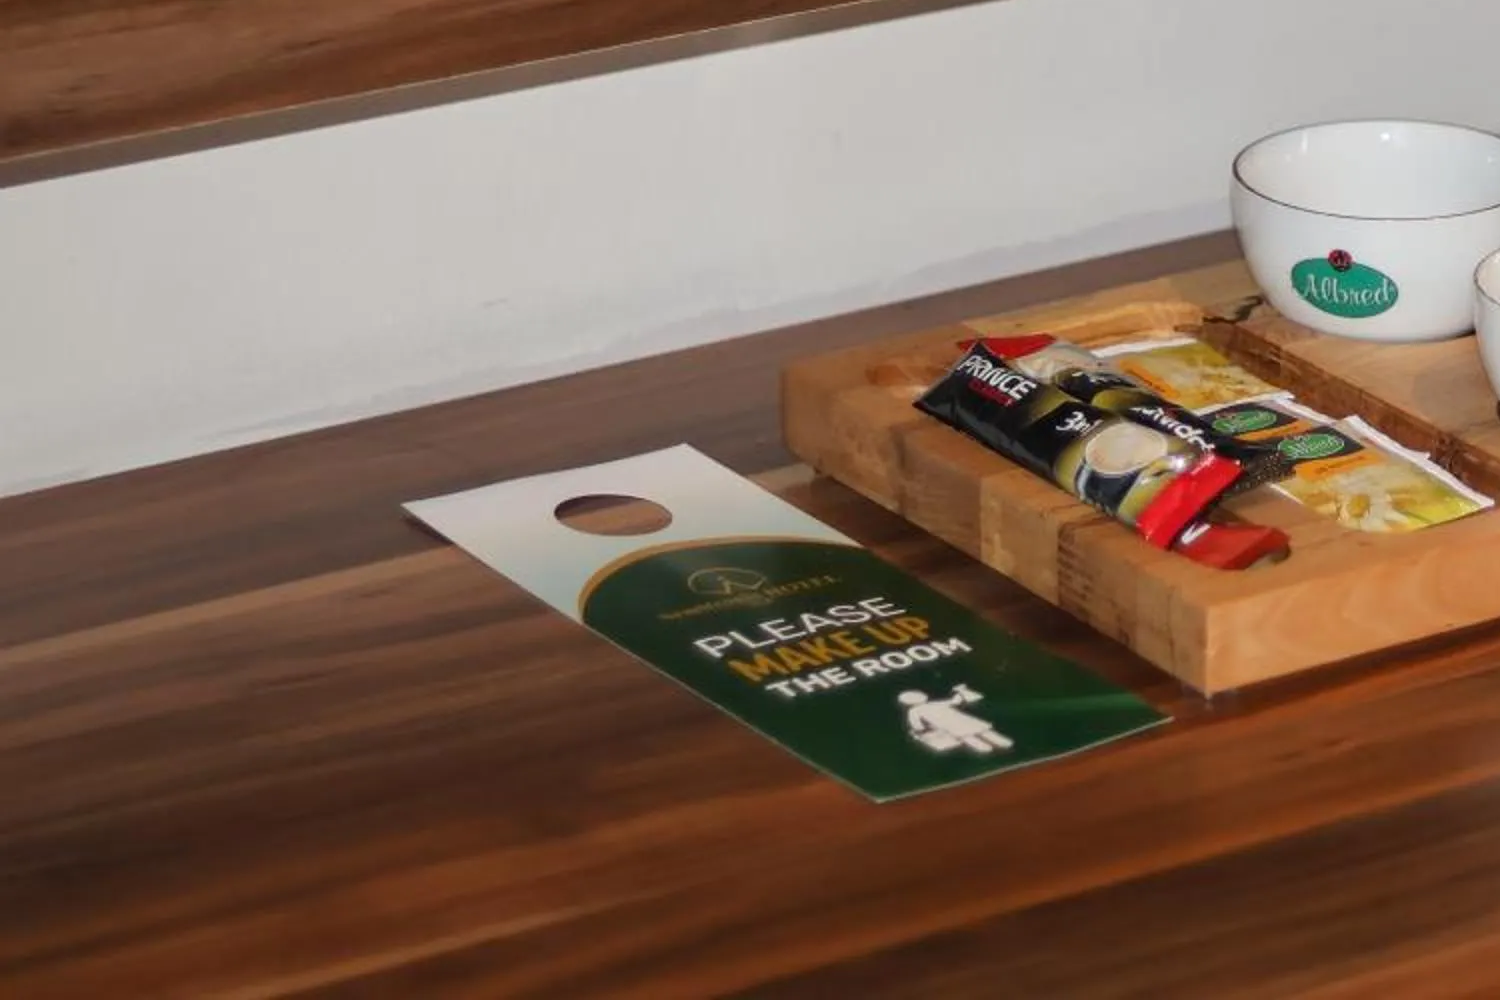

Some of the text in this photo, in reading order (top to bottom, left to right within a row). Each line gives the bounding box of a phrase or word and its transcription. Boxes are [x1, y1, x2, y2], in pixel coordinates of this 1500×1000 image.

[1302, 272, 1391, 304] Albred
[957, 354, 1037, 400] PRINCE
[693, 597, 906, 658] PLEASE
[728, 615, 930, 682] MAKE UP
[765, 637, 973, 698] THE ROOM
